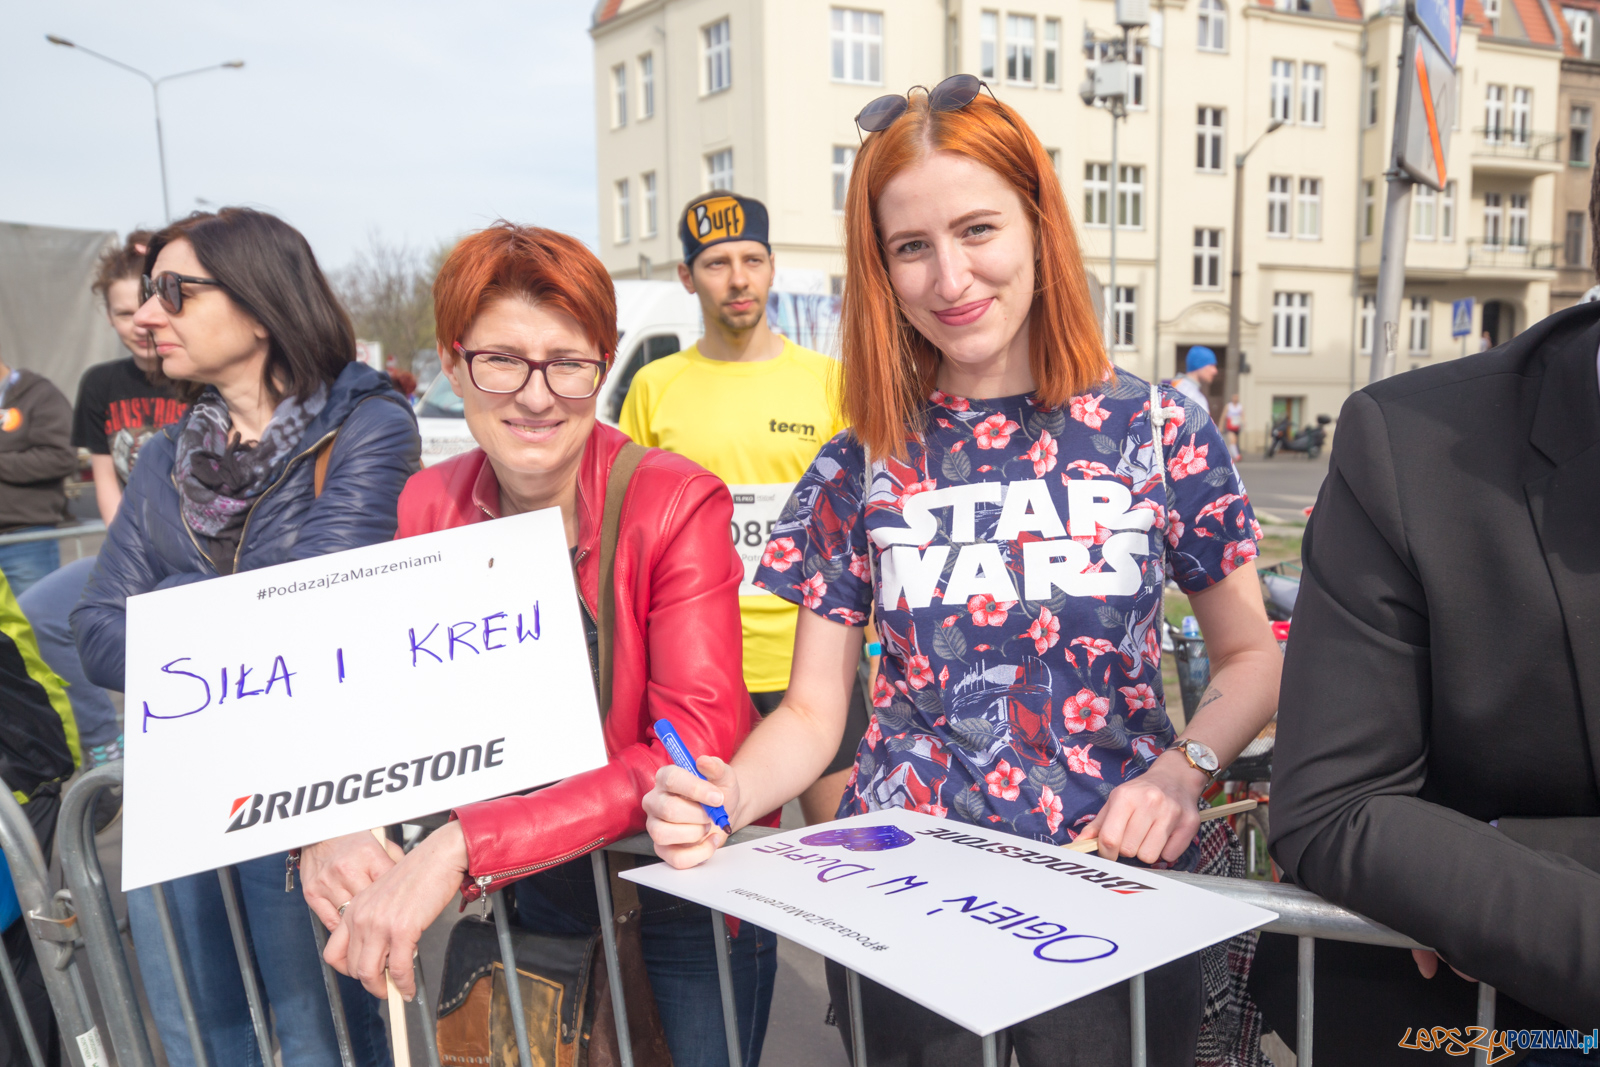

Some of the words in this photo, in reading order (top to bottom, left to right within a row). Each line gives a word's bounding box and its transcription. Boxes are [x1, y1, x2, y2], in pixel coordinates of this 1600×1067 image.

[769, 419, 815, 436] team
[870, 479, 1155, 548] STAR
[256, 551, 443, 601] #PodazajZaMarzeniami
[880, 532, 1149, 611] WARS
[408, 600, 541, 668] KREW
[224, 737, 506, 834] BRIDGESTONE
[866, 875, 929, 896] W
[915, 827, 1160, 895] BRIDGESTONE
[726, 887, 889, 952] #PodazajZaMarzeniami
